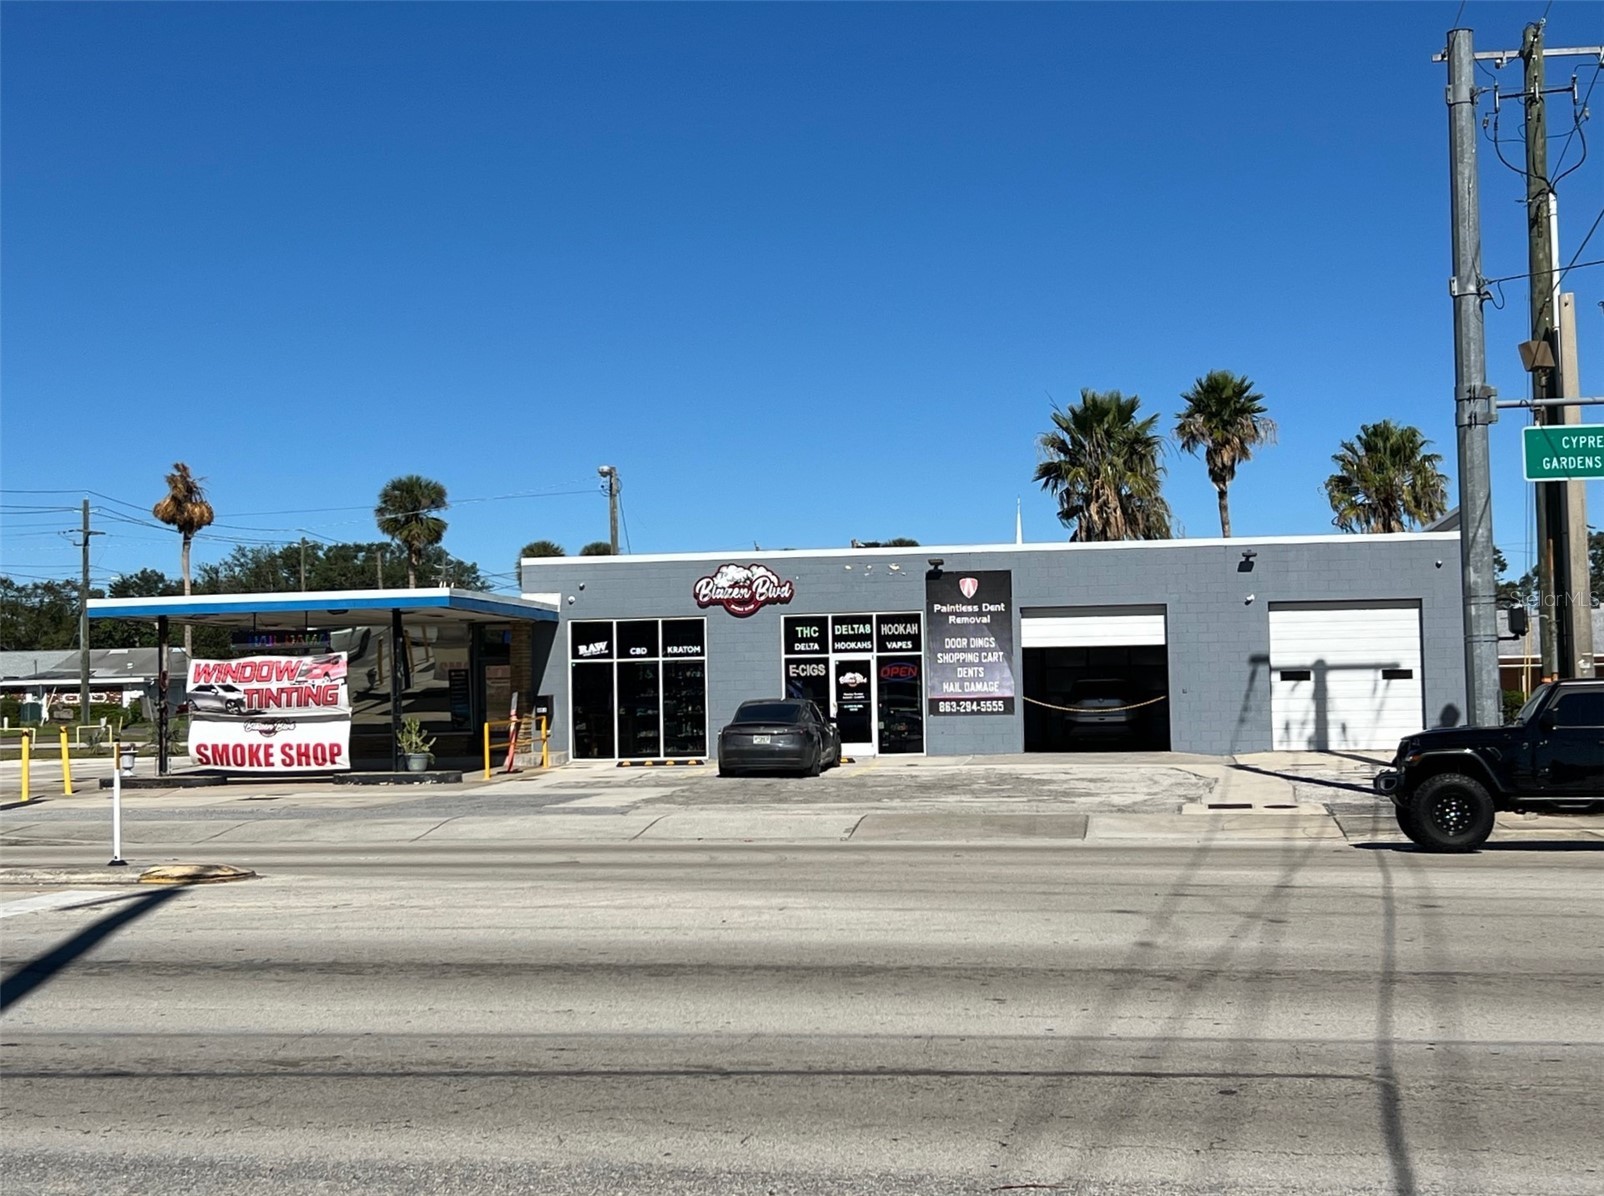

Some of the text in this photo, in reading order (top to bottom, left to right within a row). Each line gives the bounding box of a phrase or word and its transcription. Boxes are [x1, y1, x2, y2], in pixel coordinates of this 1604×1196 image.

[1542, 456, 1602, 470] GARDENS
[695, 575, 792, 602] Blazen Blvd
[933, 602, 1005, 613] Paintless Dent
[948, 615, 990, 624] Removal
[796, 626, 819, 638] THC
[834, 624, 871, 635] DELTA8
[881, 623, 918, 636] HOOKAH
[578, 641, 608, 655] RAW
[794, 643, 820, 651] DELTA
[834, 641, 872, 650] HOOKAHS
[886, 641, 912, 649] VAPES
[944, 637, 996, 649] DOOR DINGS
[629, 647, 647, 655] CBD
[667, 645, 701, 654] KRATOM
[937, 652, 1004, 663] SHOPPING CART
[193, 660, 303, 684] WINDOW
[789, 663, 826, 677] E-CIGS
[880, 666, 918, 678] OPEN
[957, 667, 985, 678] DENTS
[943, 681, 999, 693] HAIL DAMAGE
[243, 684, 340, 709] TINTING
[939, 701, 1004, 712] 863-294-5555
[195, 742, 342, 767] SMOKE SHOP
